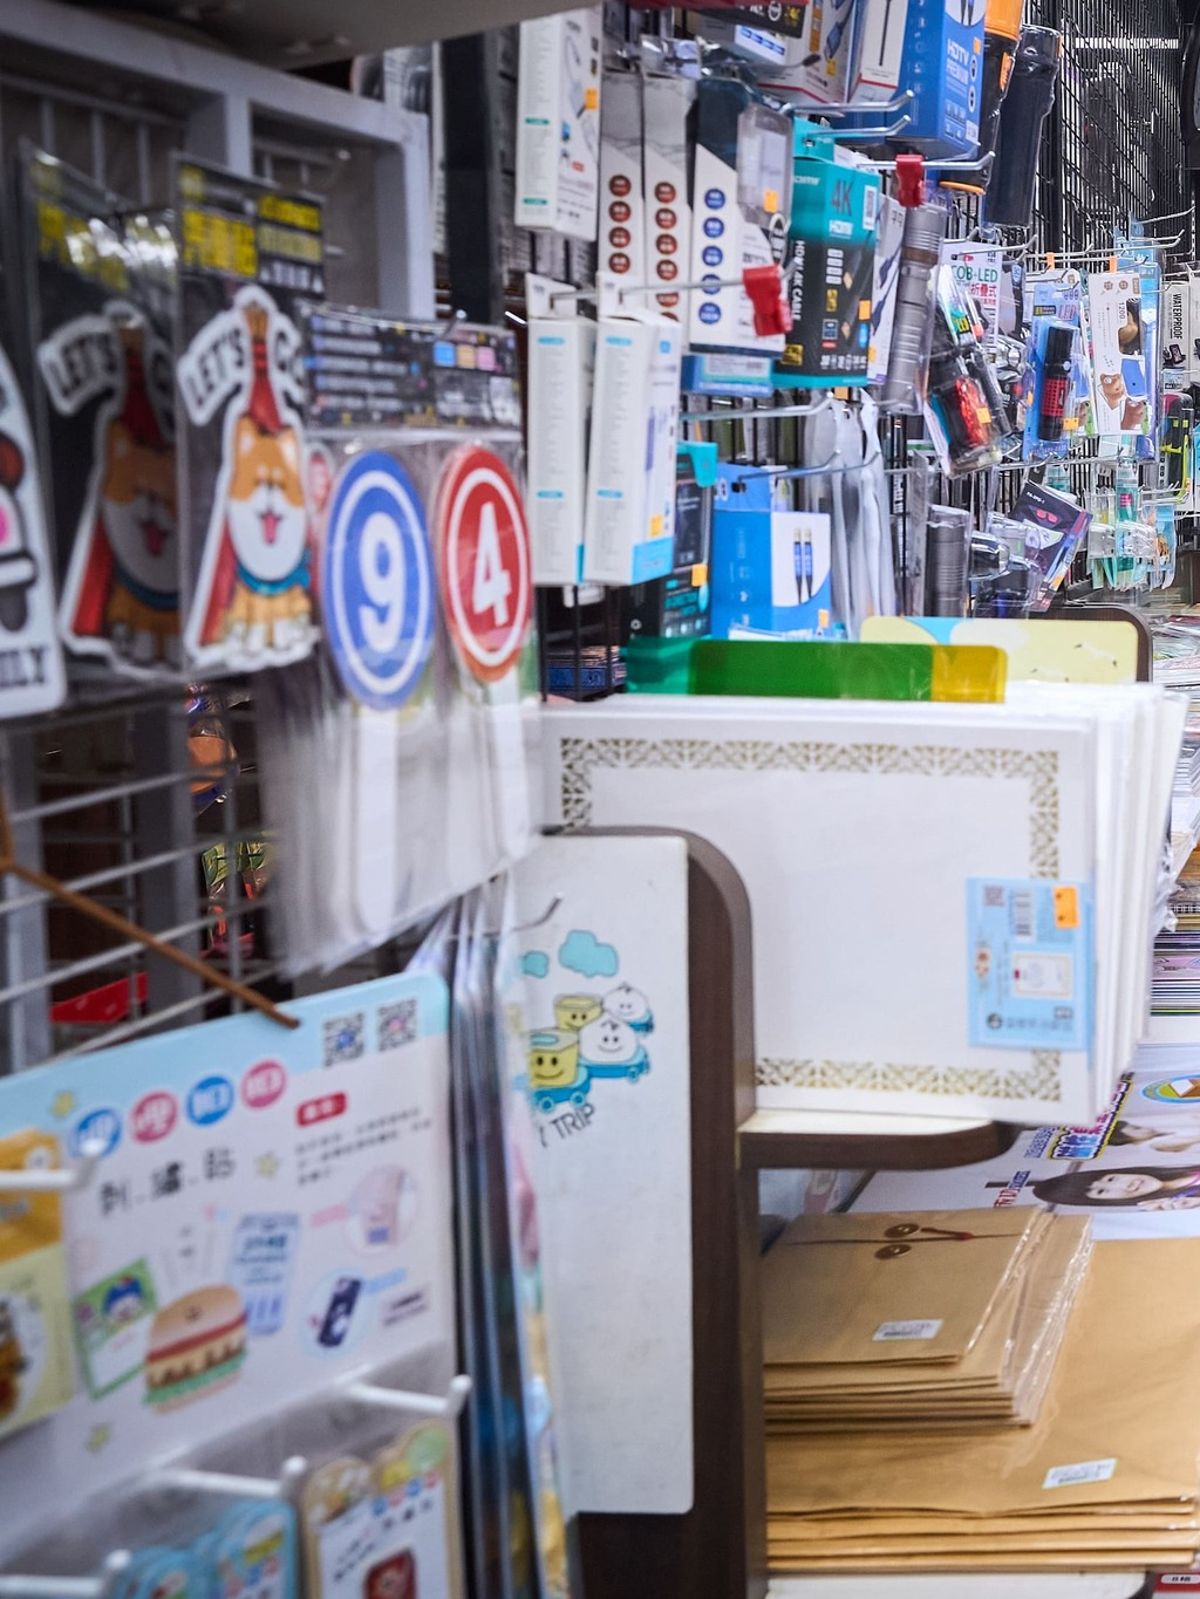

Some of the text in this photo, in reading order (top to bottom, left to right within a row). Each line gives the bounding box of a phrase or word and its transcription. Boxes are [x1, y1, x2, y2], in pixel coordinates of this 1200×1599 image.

[1173, 294, 1183, 339] WATERPROOF
[359, 512, 402, 654] 9
[474, 502, 510, 626] 4
[551, 1102, 596, 1139] TRIP
